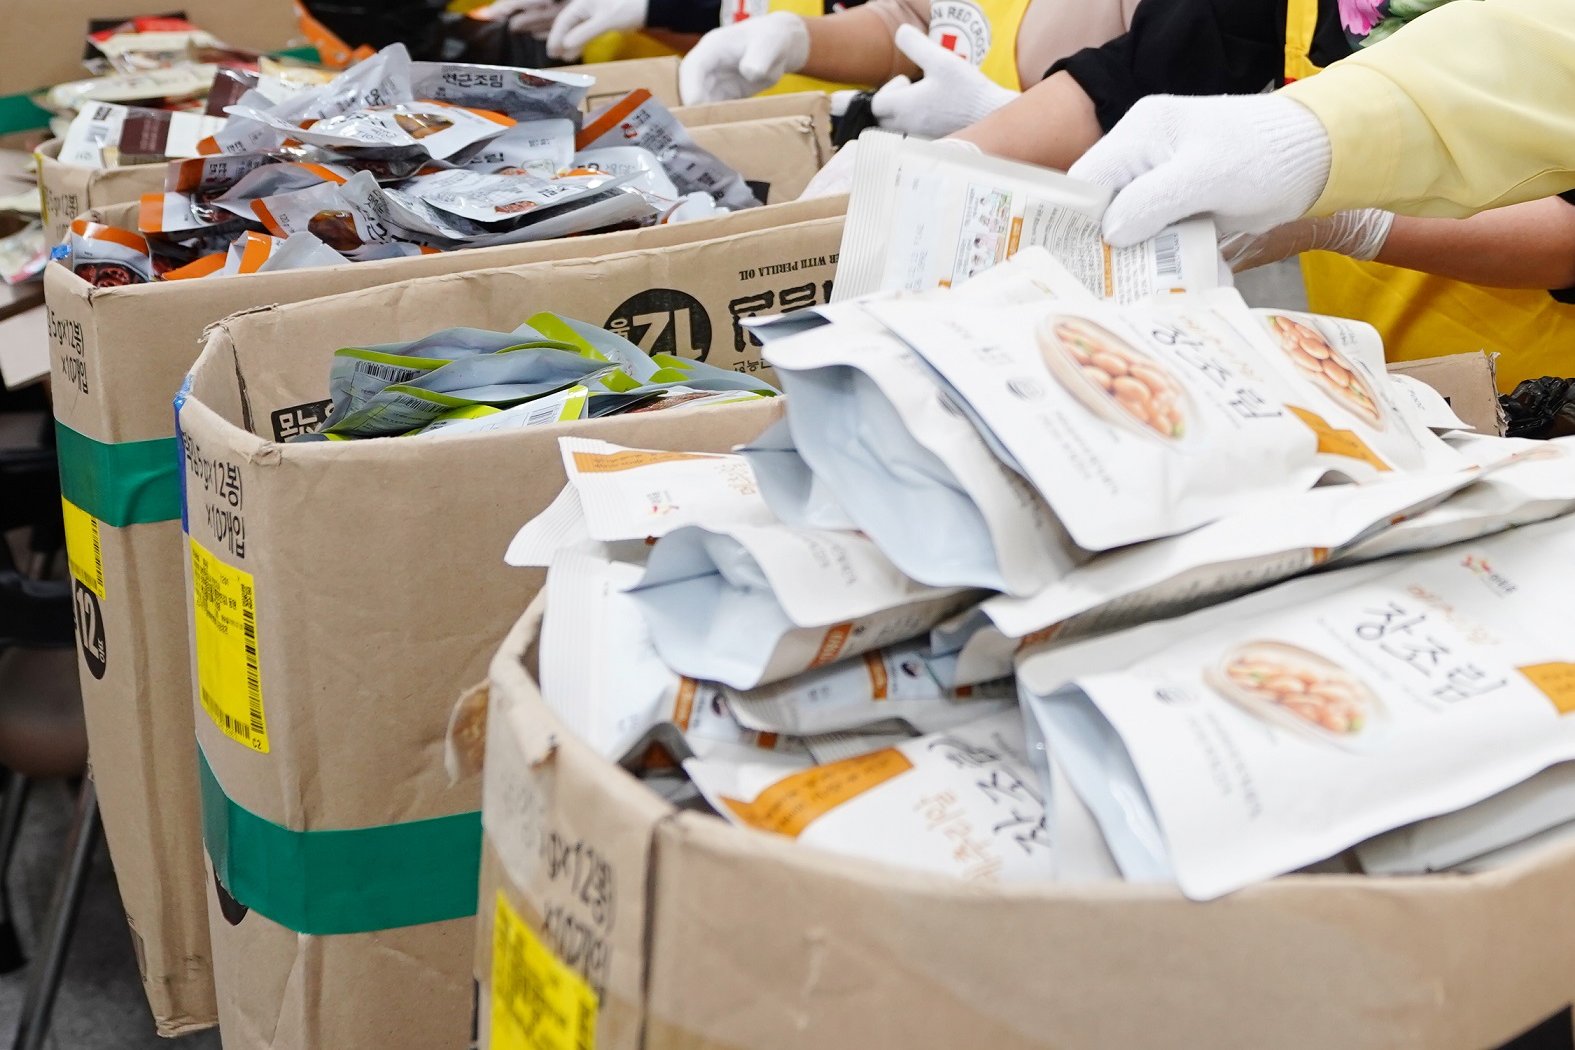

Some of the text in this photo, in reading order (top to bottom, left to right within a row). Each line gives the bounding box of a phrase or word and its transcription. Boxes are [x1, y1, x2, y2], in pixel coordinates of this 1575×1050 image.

[739, 270, 756, 281] OIL
[757, 260, 799, 278] PERILLA
[1355, 601, 1508, 704] 장조림
